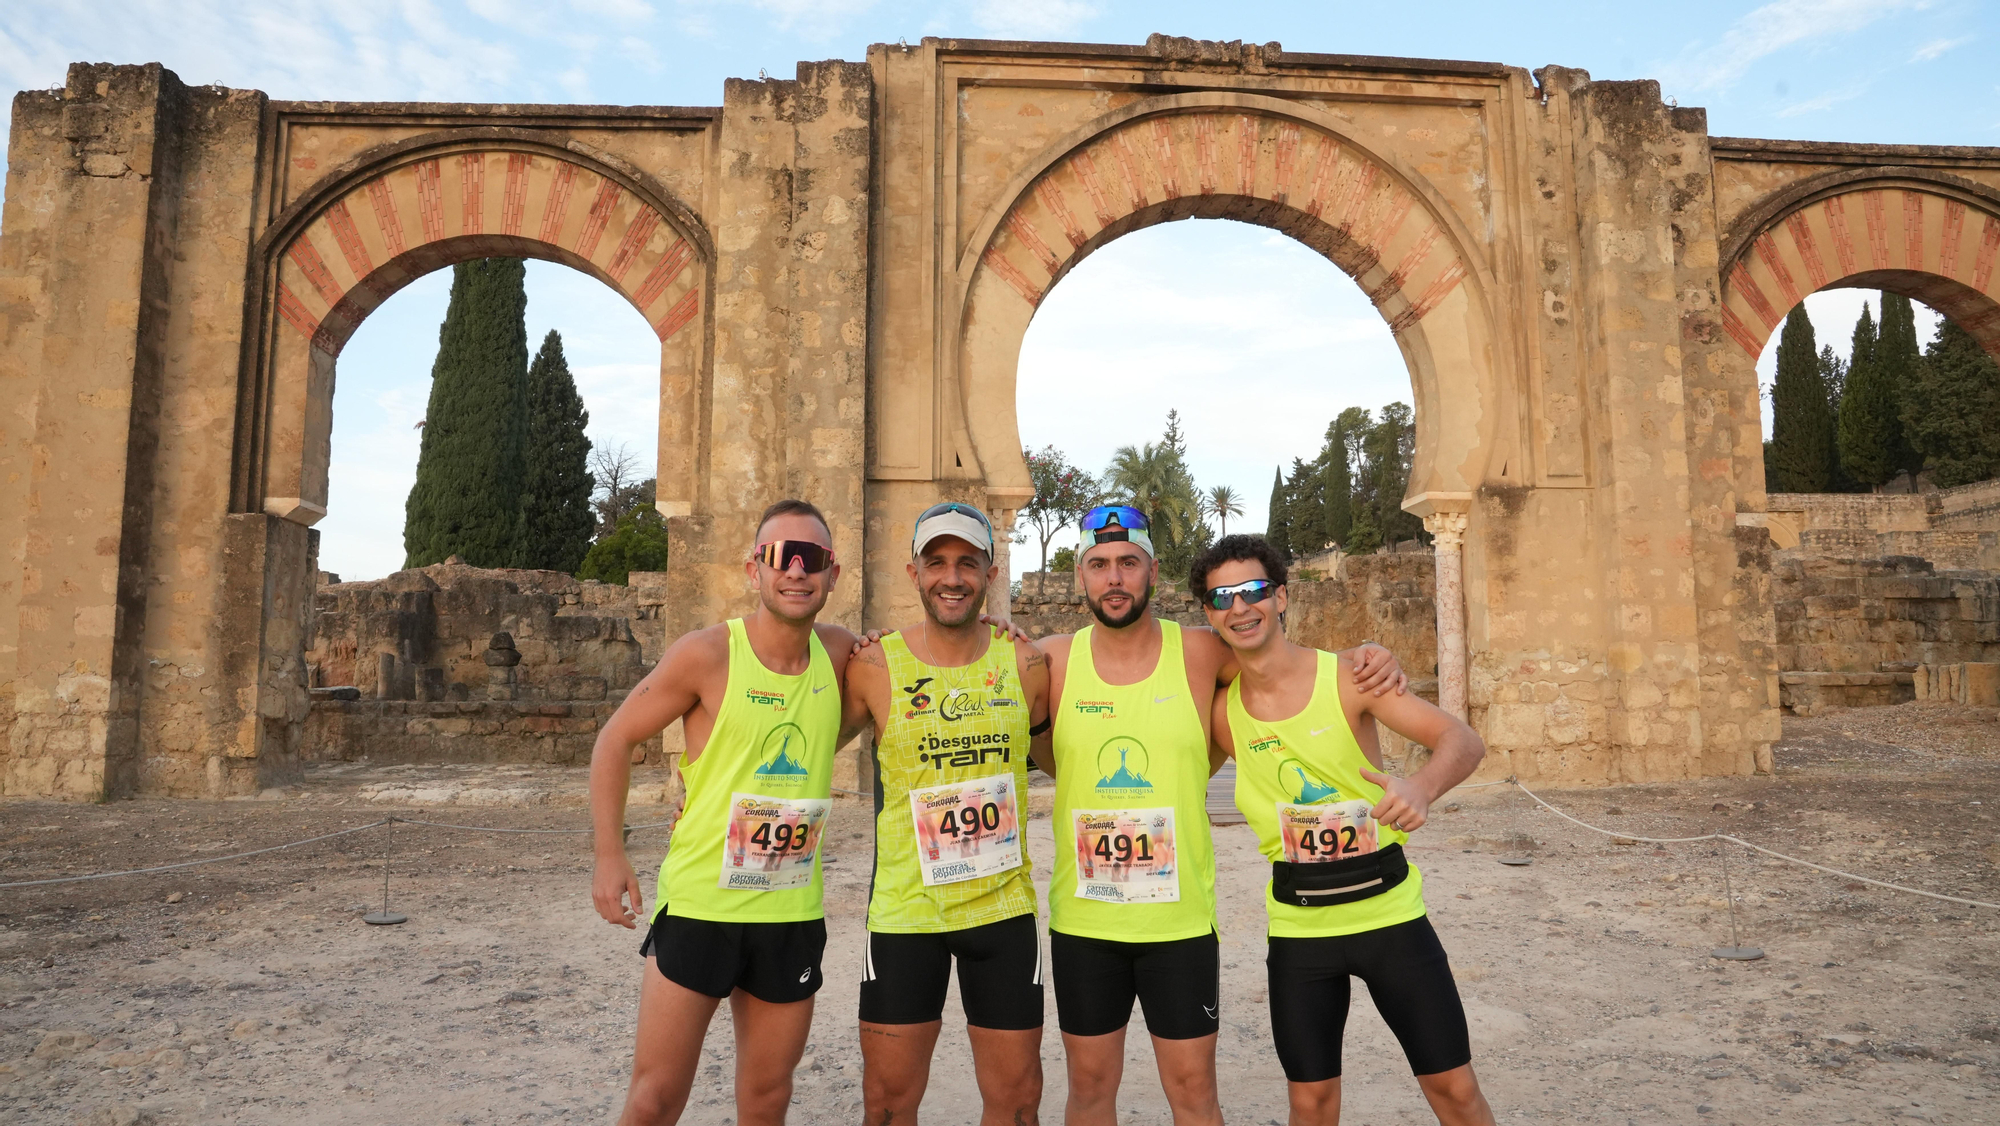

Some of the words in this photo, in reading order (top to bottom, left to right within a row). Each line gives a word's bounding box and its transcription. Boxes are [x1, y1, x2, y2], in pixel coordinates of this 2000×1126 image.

[750, 688, 785, 698] desguace
[928, 733, 1010, 750] Desguace
[1251, 735, 1278, 745] desguace
[1129, 787, 1154, 795] SIQUISA
[939, 802, 1000, 838] 490
[750, 822, 809, 851] 493
[1300, 825, 1359, 856] 492
[1094, 833, 1154, 862] 491
[932, 862, 969, 873] carreras
[932, 866, 977, 880] populares
[728, 877, 771, 886] populares
[1085, 889, 1124, 897] populares
